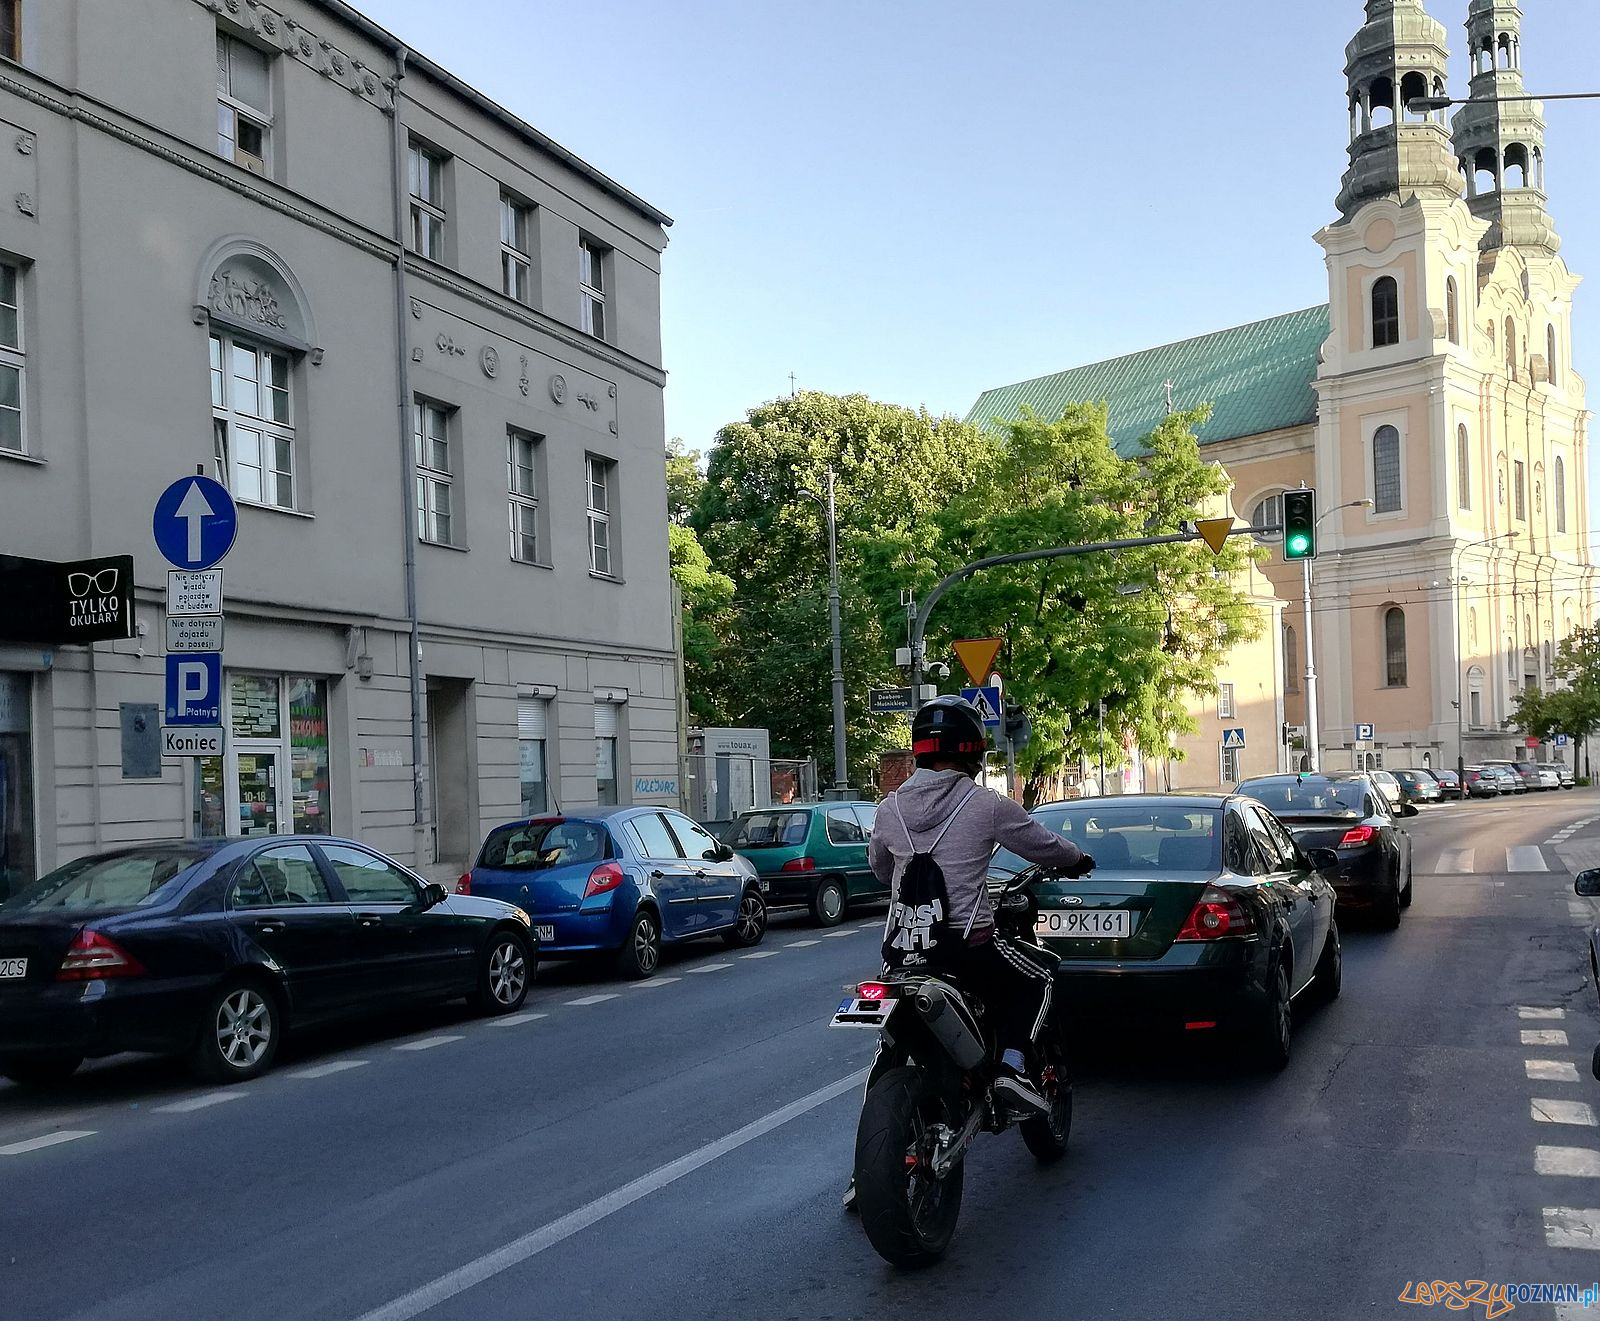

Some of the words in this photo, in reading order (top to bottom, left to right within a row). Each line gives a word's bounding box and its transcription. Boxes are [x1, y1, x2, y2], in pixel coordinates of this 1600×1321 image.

[190, 573, 216, 582] dotyczy
[183, 582, 206, 591] wjazdu
[69, 596, 118, 616] TYLKO
[70, 612, 118, 626] OKULARY
[188, 620, 216, 628] dotyczy
[179, 630, 210, 639] dojazdu
[188, 640, 214, 649] posesji
[178, 662, 208, 716] P
[186, 707, 211, 718] Płatny
[166, 733, 216, 750] Koniec
[244, 792, 266, 802] 10-18
[1036, 914, 1060, 930] PO
[1068, 914, 1122, 932] 9K161
[0, 960, 25, 976] 2CS
